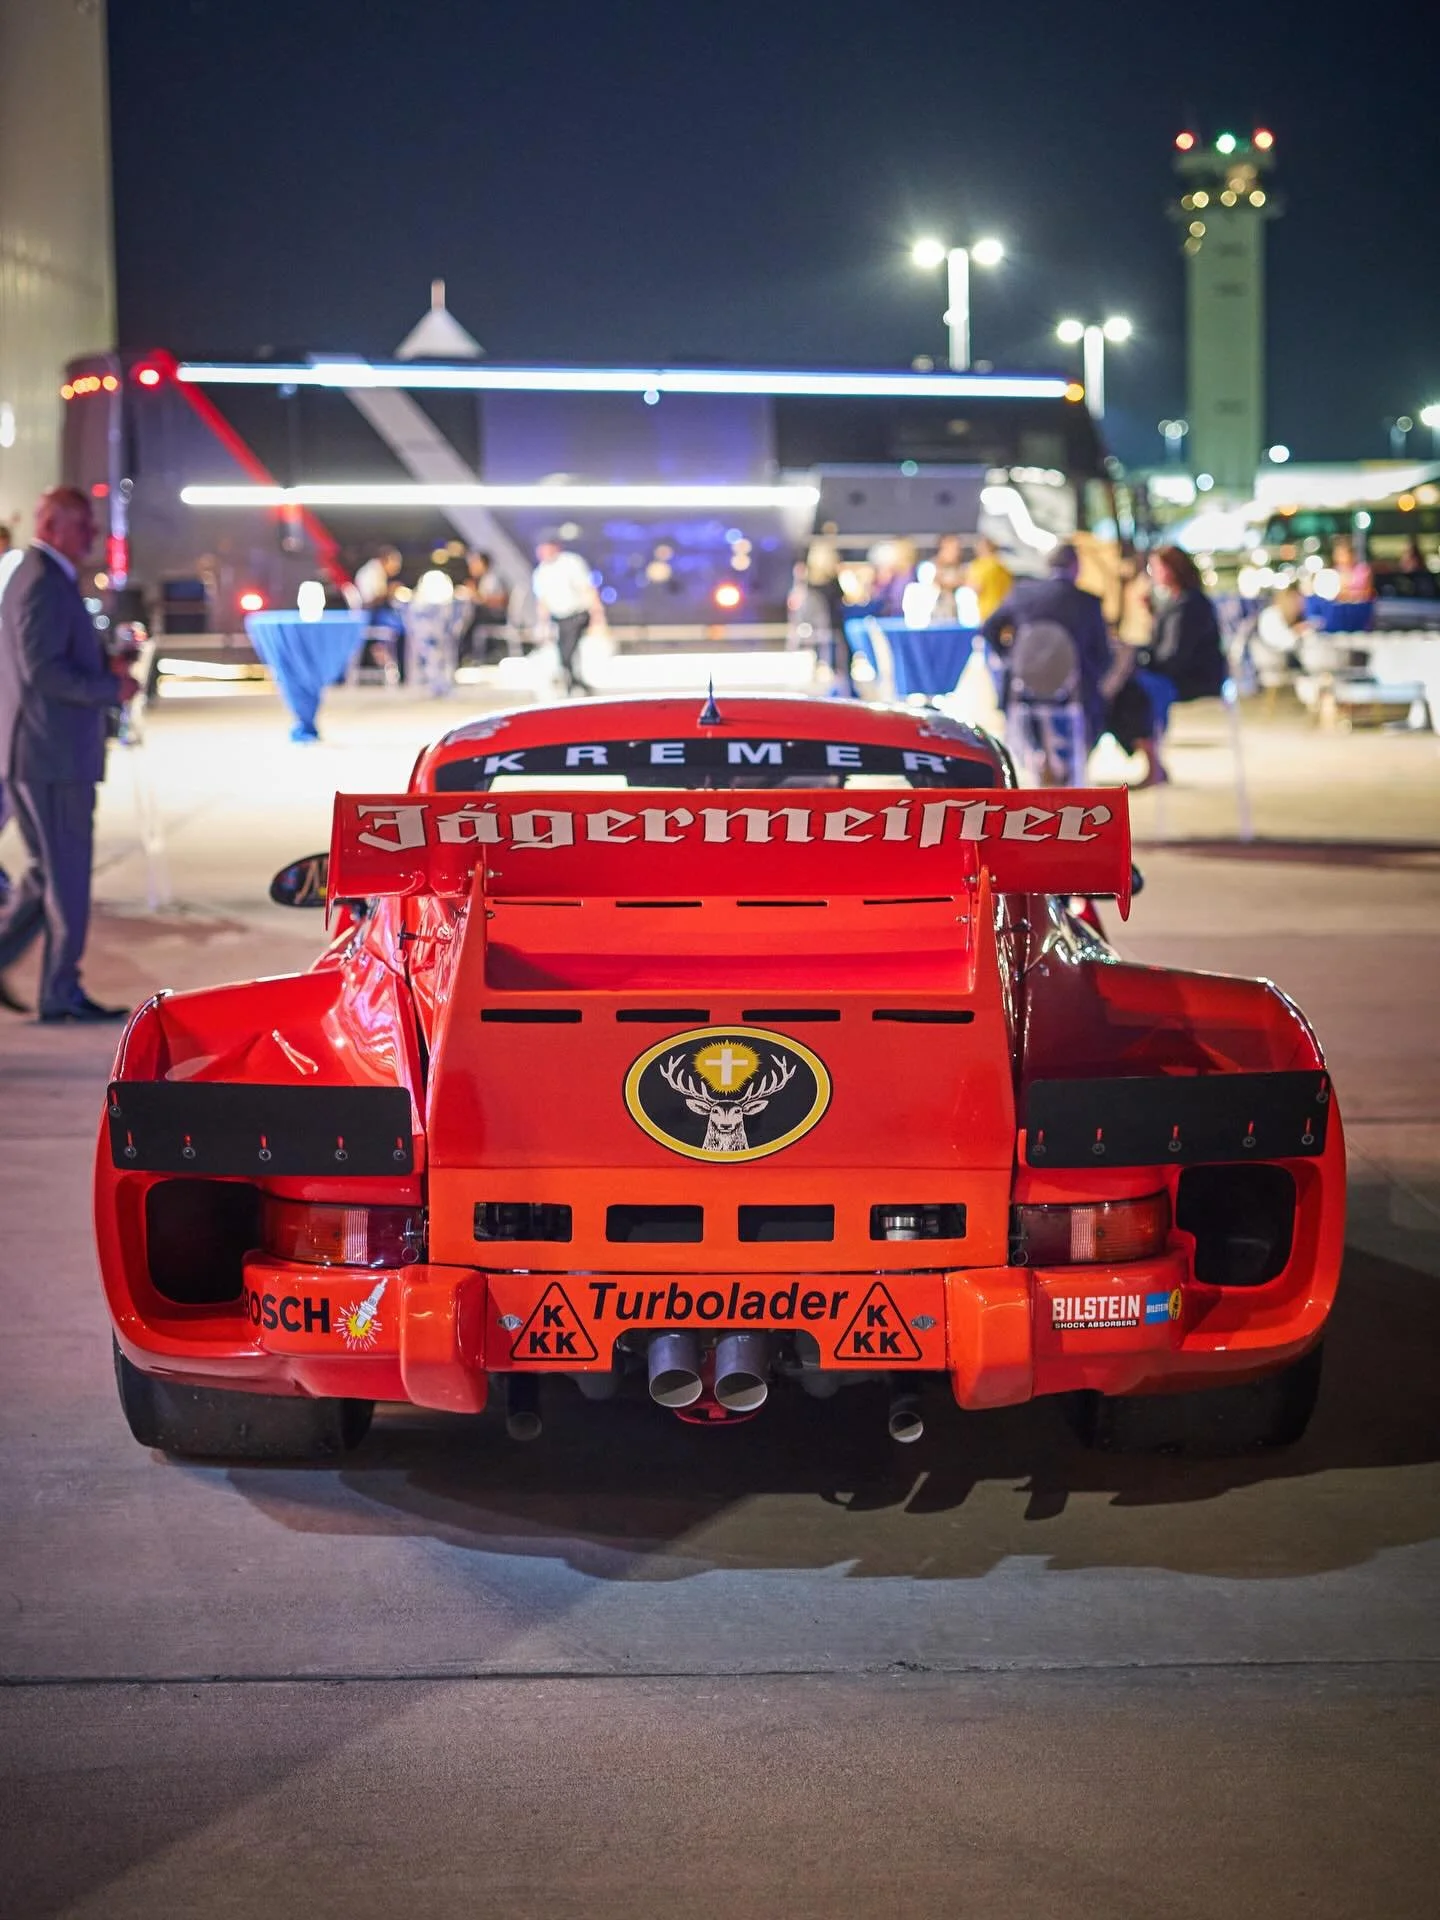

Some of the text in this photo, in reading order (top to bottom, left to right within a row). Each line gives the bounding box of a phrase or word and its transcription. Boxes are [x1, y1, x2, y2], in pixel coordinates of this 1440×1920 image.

[484, 742, 947, 775] KREMER
[588, 1282, 849, 1320] Turbolader
[1053, 1295, 1140, 1320] BILSTEIN
[1055, 1319, 1137, 1329] SHOCK ABSORBERS
